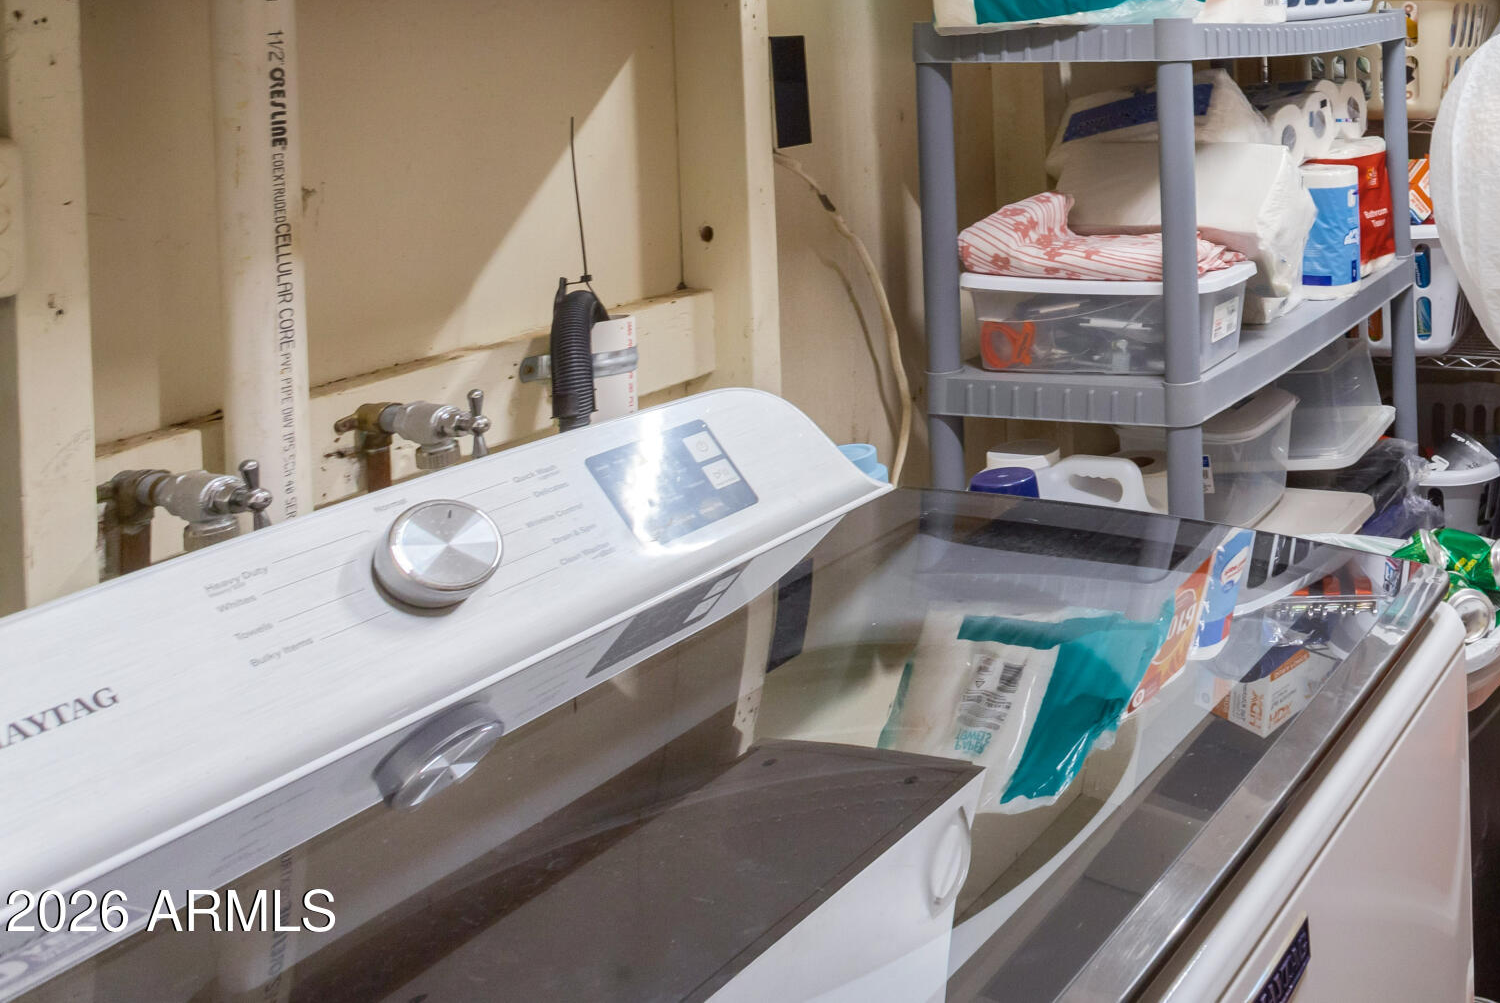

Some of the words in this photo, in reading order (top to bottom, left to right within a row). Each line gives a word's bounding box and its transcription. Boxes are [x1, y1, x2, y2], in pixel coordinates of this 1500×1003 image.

[269, 67, 288, 149] CRESLINE
[272, 152, 288, 224] COEXTRUDED
[274, 222, 294, 304] CELLULAR
[279, 308, 296, 351] CORE
[280, 377, 294, 405] PIPE
